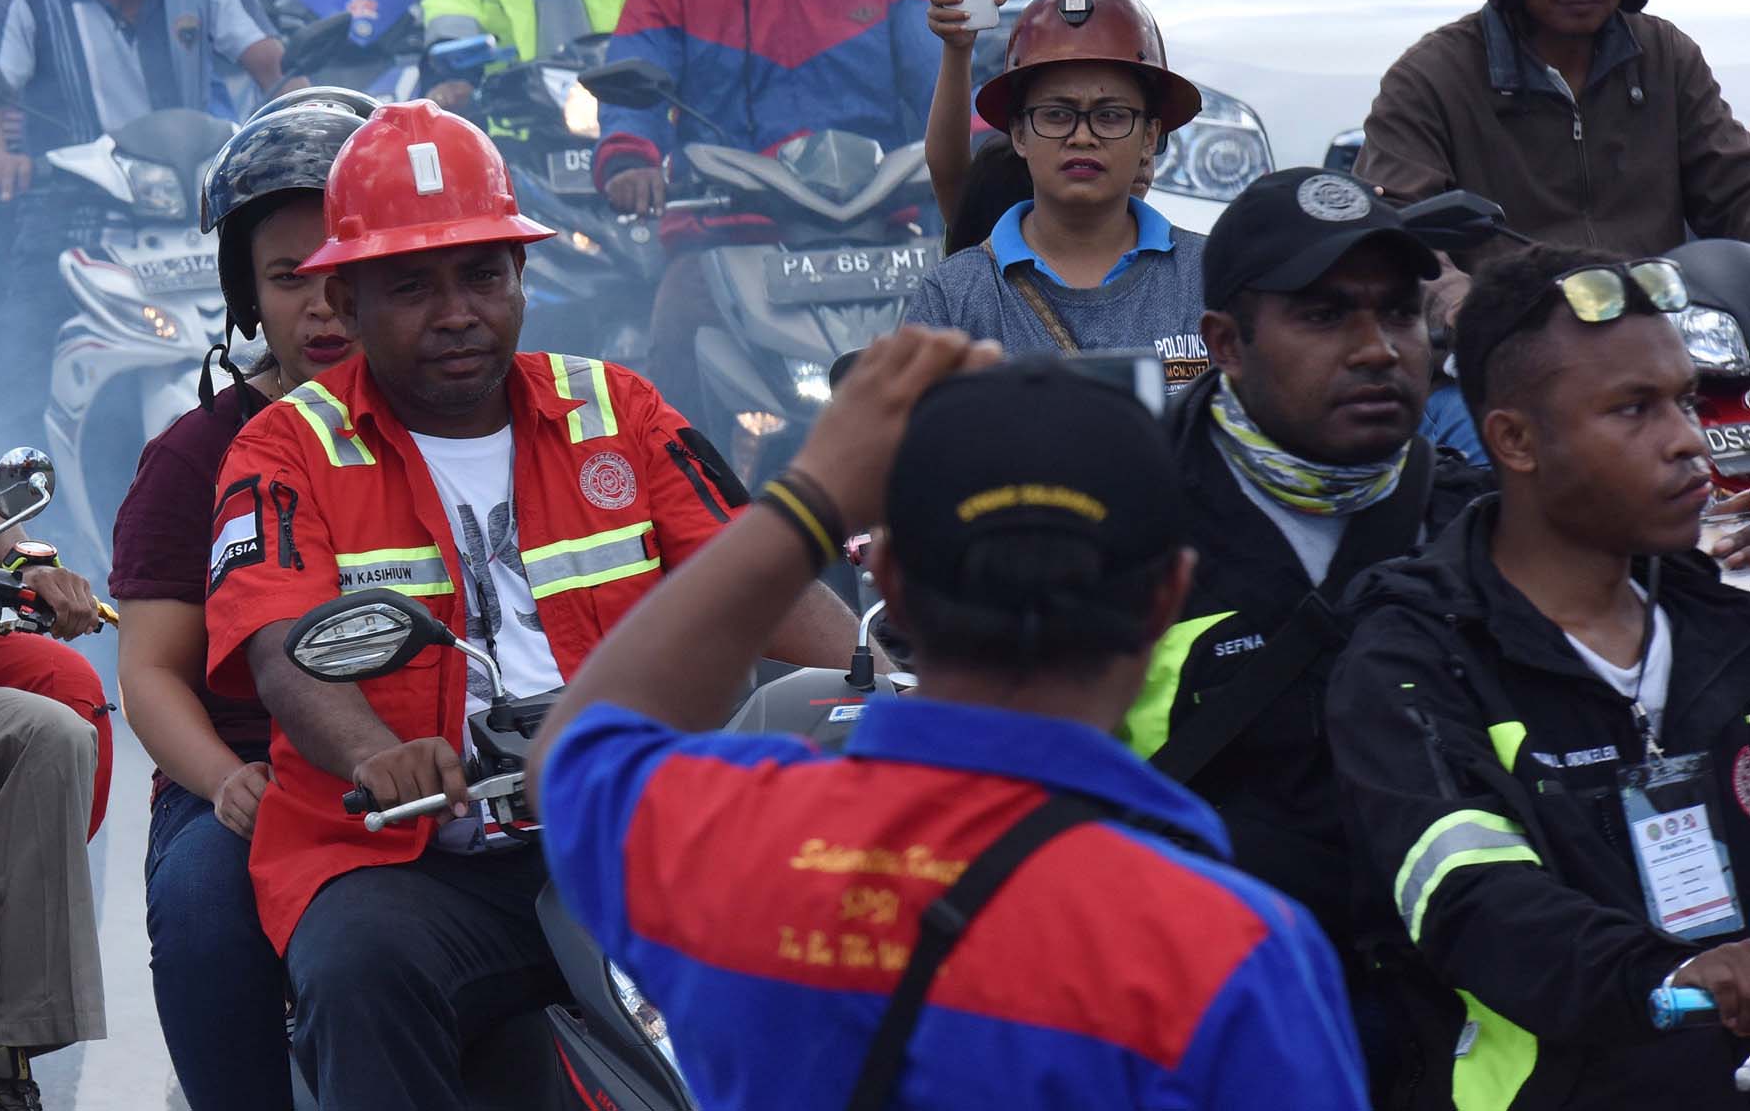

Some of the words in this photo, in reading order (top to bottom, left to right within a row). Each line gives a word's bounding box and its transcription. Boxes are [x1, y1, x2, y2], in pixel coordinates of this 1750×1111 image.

[783, 256, 815, 276] PA
[837, 253, 871, 273] 66
[891, 247, 928, 269] MT
[357, 567, 413, 585] KASIHIUW
[1214, 634, 1266, 656] SEFNA
